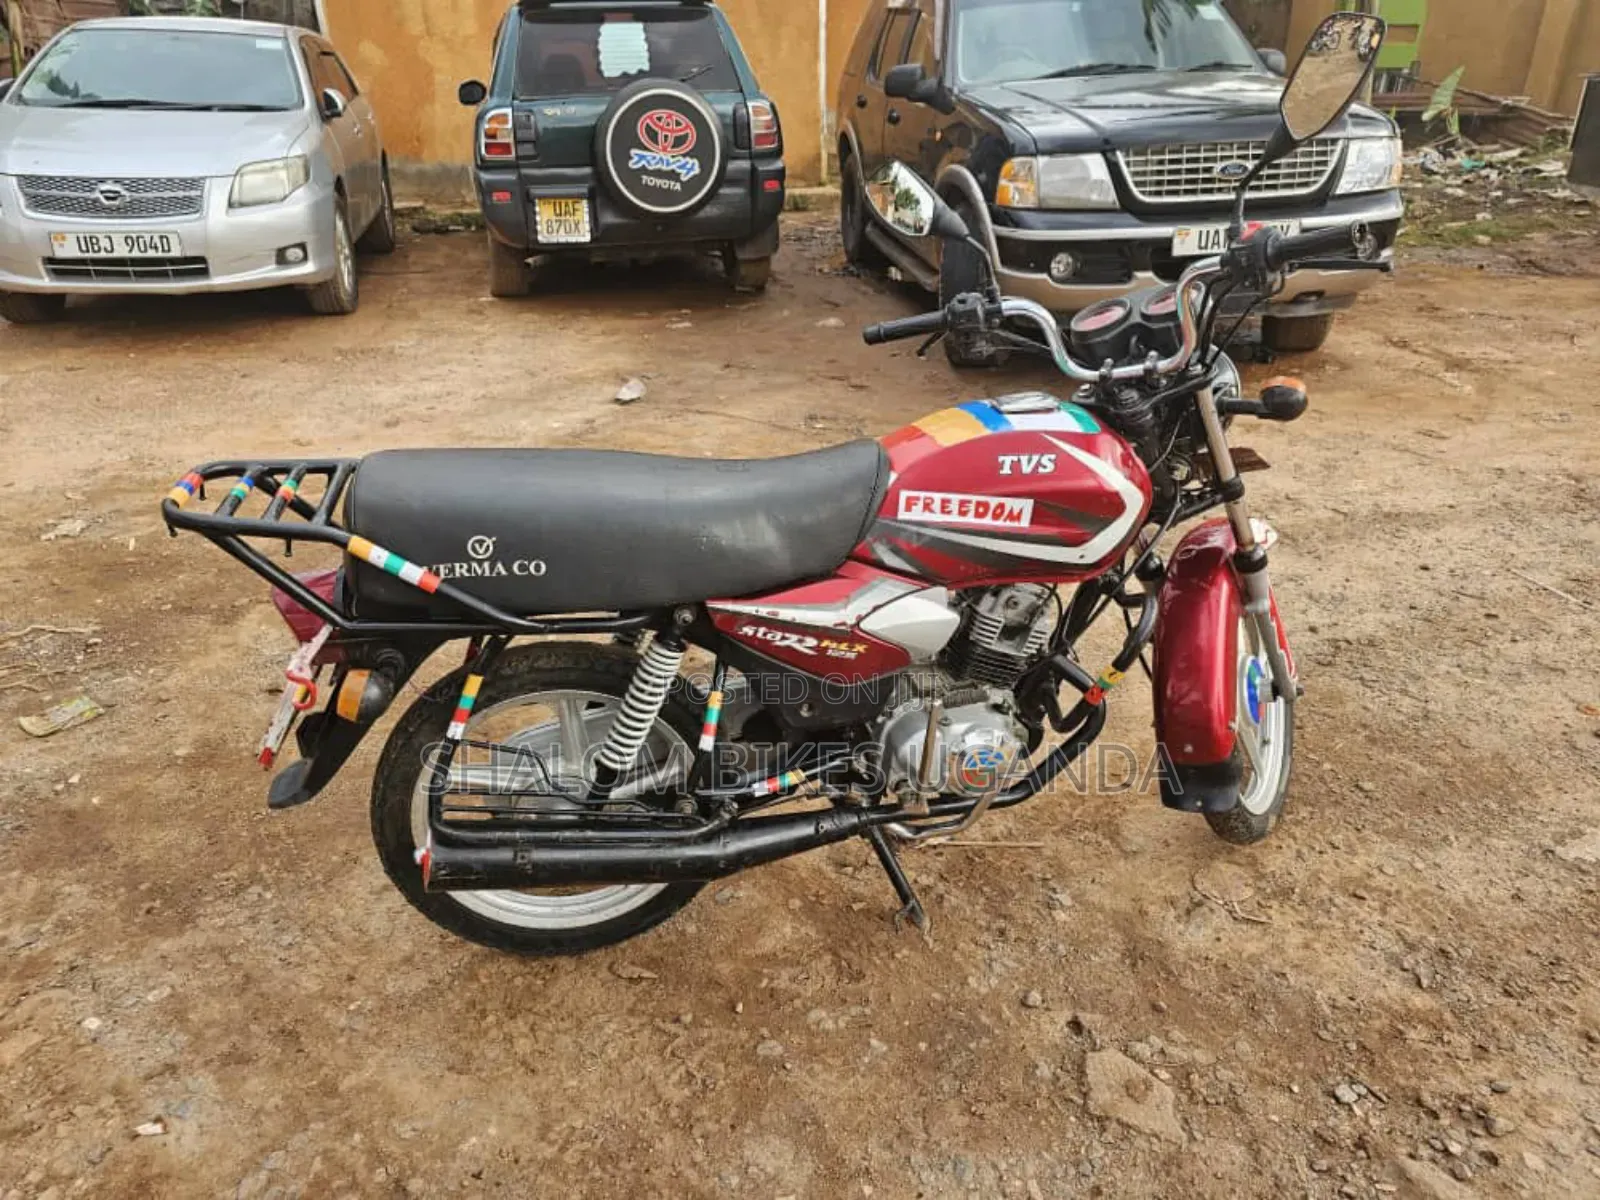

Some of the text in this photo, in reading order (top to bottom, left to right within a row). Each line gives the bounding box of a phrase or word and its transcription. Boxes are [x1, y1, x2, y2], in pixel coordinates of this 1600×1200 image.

[629, 148, 701, 182] RAV4
[641, 175, 682, 192] TOYOTA
[553, 201, 581, 217] UAF
[76, 234, 172, 254] UBJ 904D
[998, 453, 1057, 475] TVS
[904, 495, 1024, 523] FREEDOM
[512, 559, 547, 576] CO
